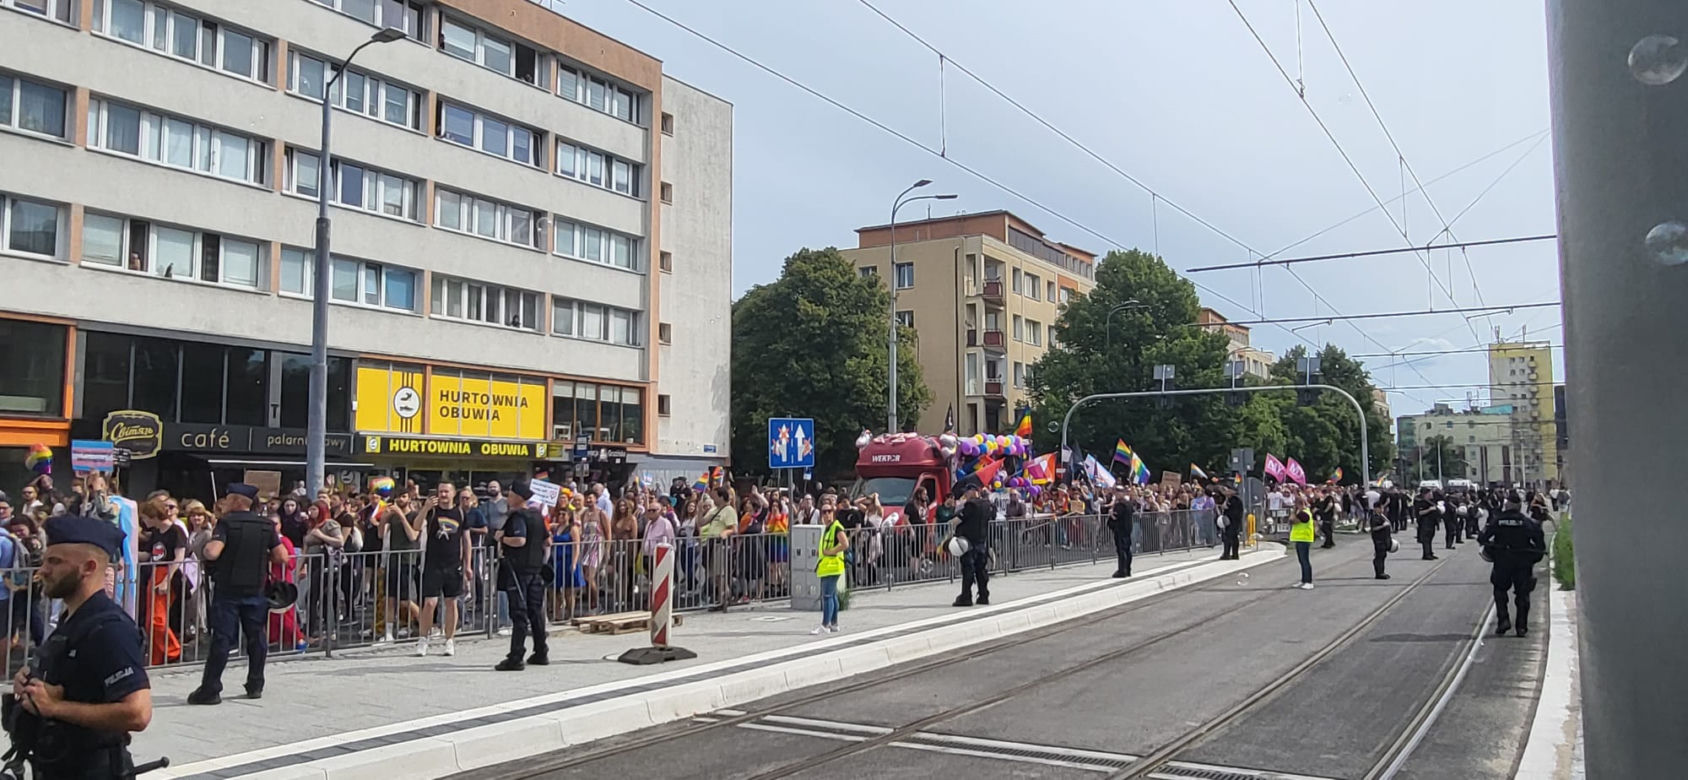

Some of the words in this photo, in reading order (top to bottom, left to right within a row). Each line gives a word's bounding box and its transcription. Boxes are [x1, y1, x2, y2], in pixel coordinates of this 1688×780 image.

[440, 390, 528, 408] HURTOWNIA
[440, 406, 500, 421] OBUWIA
[181, 428, 230, 448] café
[267, 433, 308, 448] palarni
[389, 439, 471, 454] HURTOWNIA
[481, 443, 529, 456] OBUWIA
